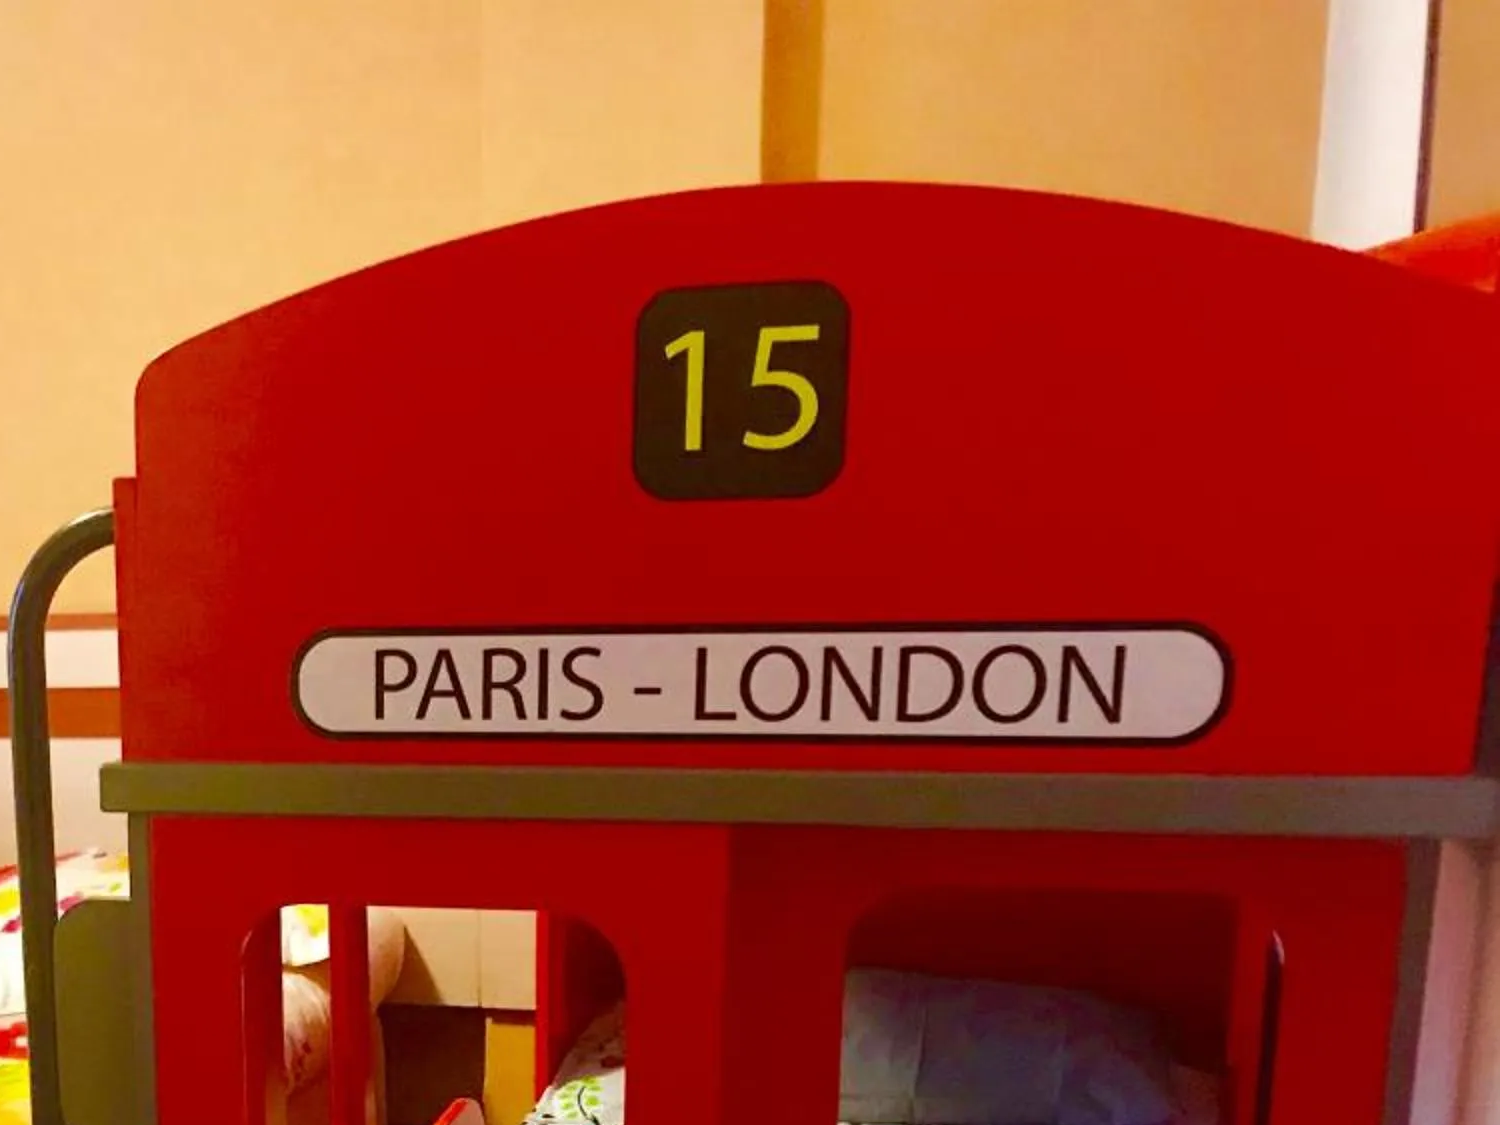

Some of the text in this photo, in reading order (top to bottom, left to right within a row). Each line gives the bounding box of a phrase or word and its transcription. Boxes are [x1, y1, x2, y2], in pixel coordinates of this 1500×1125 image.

[664, 324, 820, 451] 15
[373, 646, 605, 722] PARIS
[695, 643, 1127, 724] LONDON
